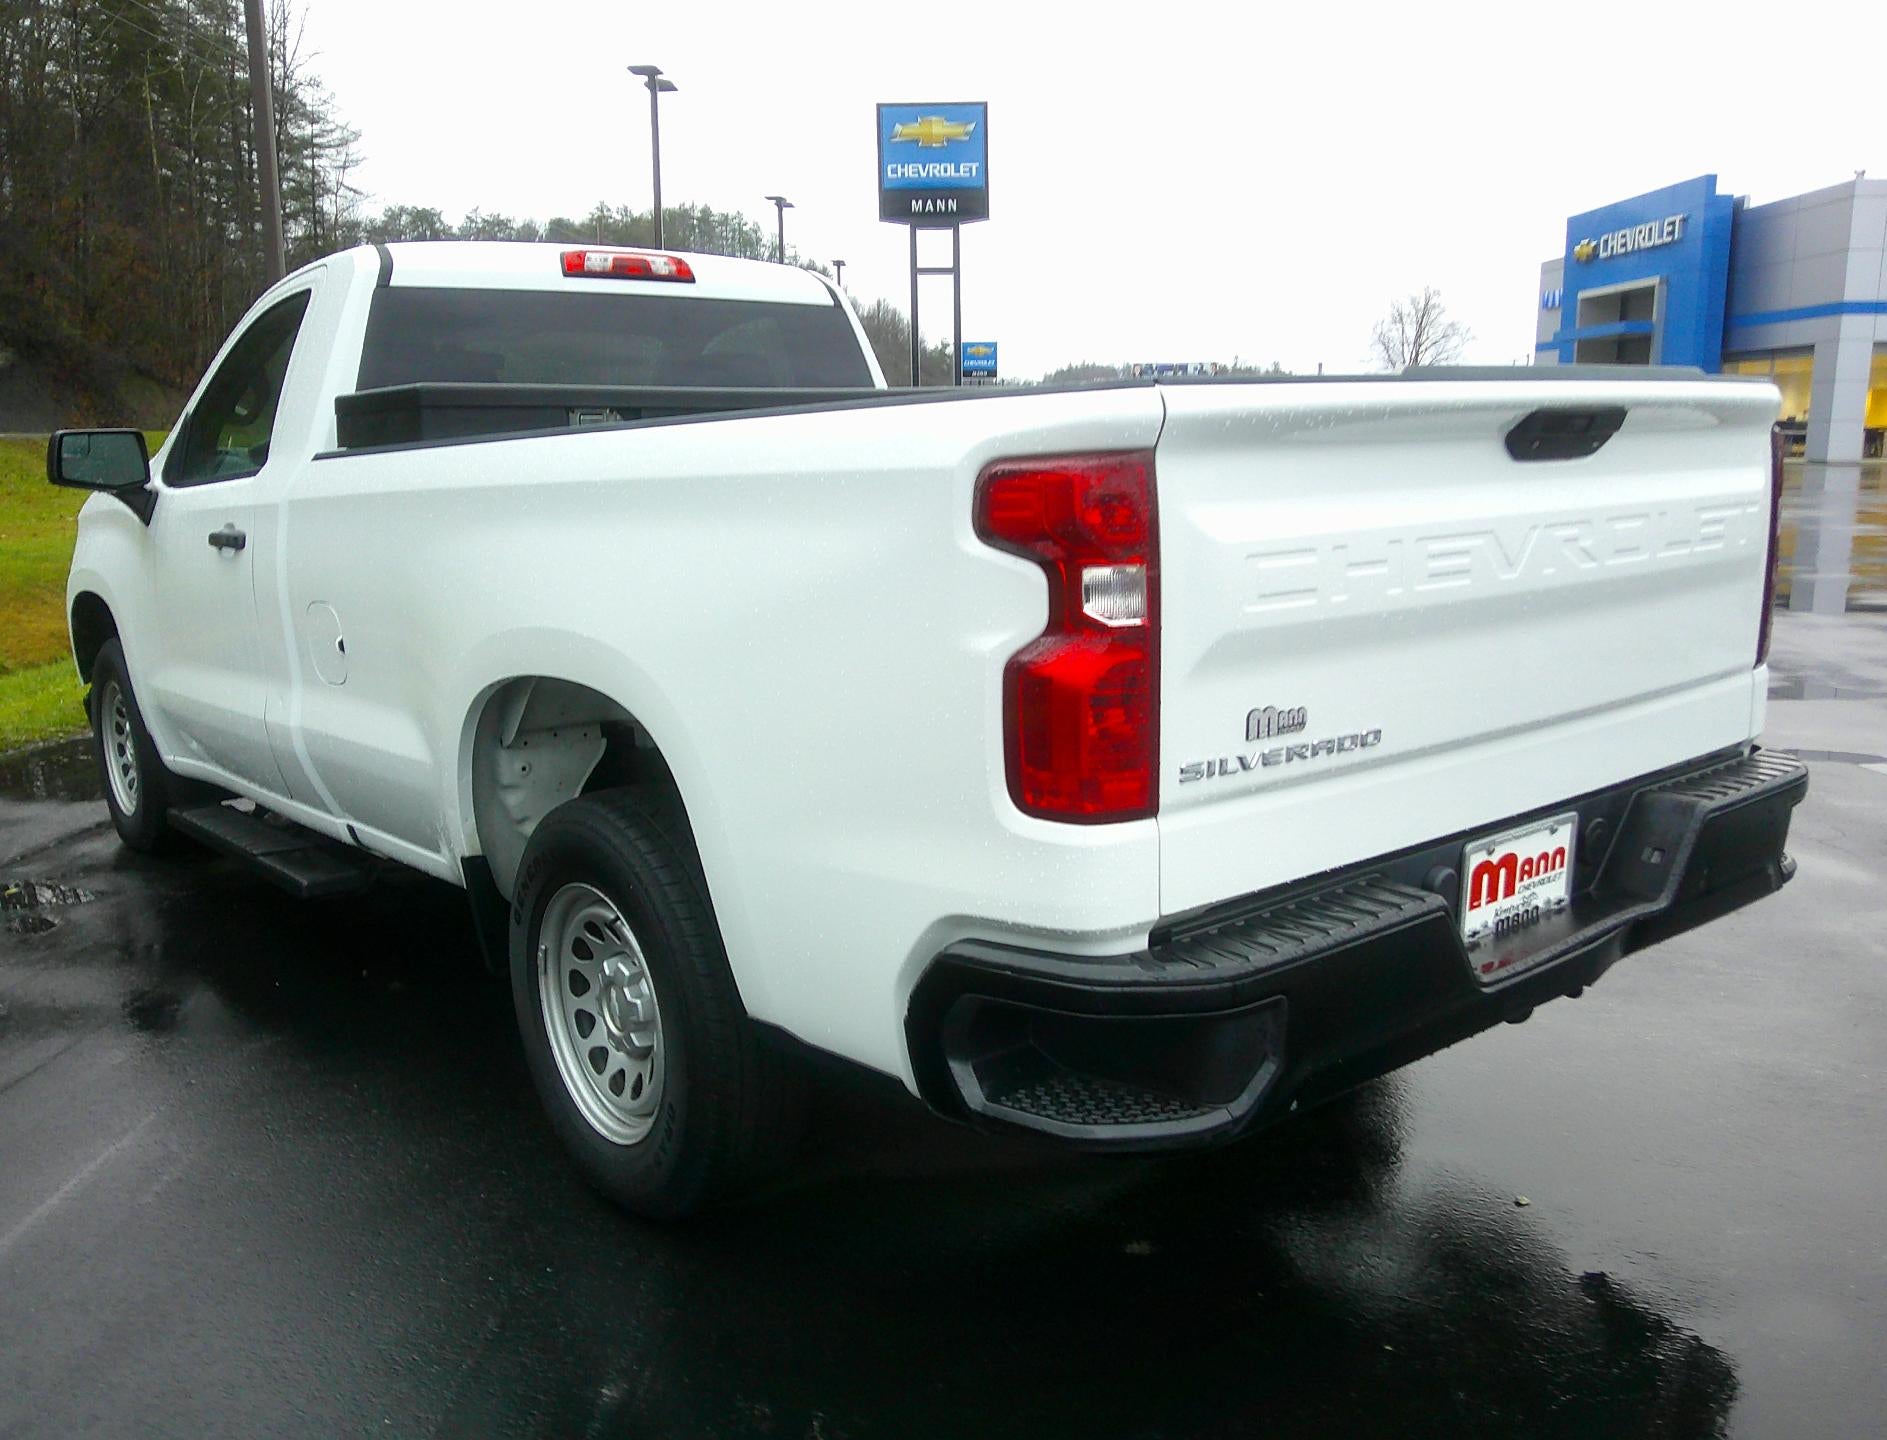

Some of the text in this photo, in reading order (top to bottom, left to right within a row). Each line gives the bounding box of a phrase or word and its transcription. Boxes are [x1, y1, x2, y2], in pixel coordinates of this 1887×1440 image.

[887, 162, 979, 179] CHEVROLET
[911, 198, 957, 212] MANN
[1600, 214, 1684, 259] CHEVROLET
[1179, 729, 1382, 783] SILVERADO
[1518, 871, 1563, 894] CHEVROLET
